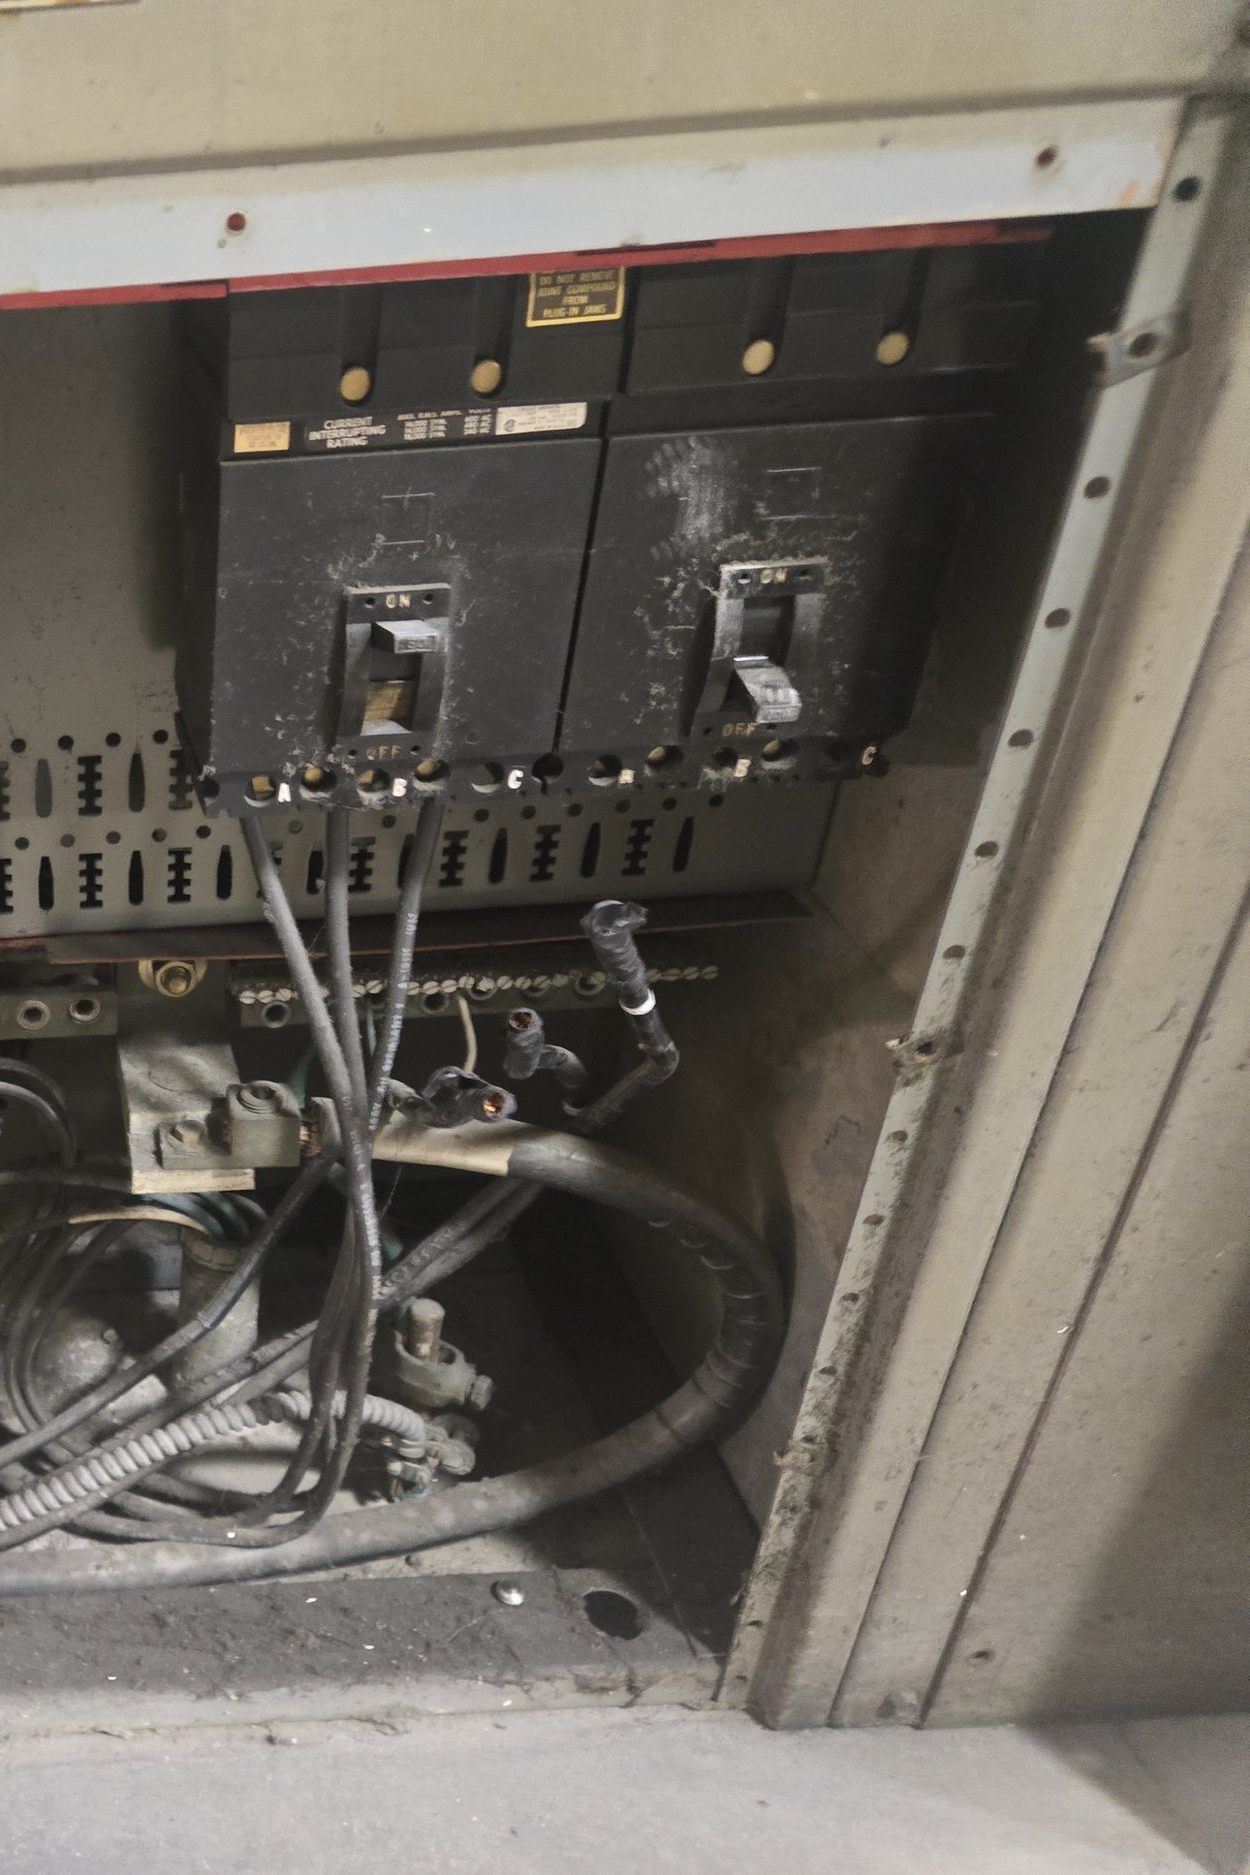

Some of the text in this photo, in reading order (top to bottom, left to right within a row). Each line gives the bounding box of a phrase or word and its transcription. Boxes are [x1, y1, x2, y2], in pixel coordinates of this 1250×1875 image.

[564, 281, 618, 295] COMPOUND
[323, 416, 373, 430] CURRENT
[308, 424, 387, 441] INTERRUPTING
[325, 436, 369, 449] RATING
[760, 568, 788, 584] ON
[385, 593, 411, 609] ON
[722, 723, 757, 737] OFF
[367, 745, 401, 760] OFF
[278, 769, 524, 802] A B C
